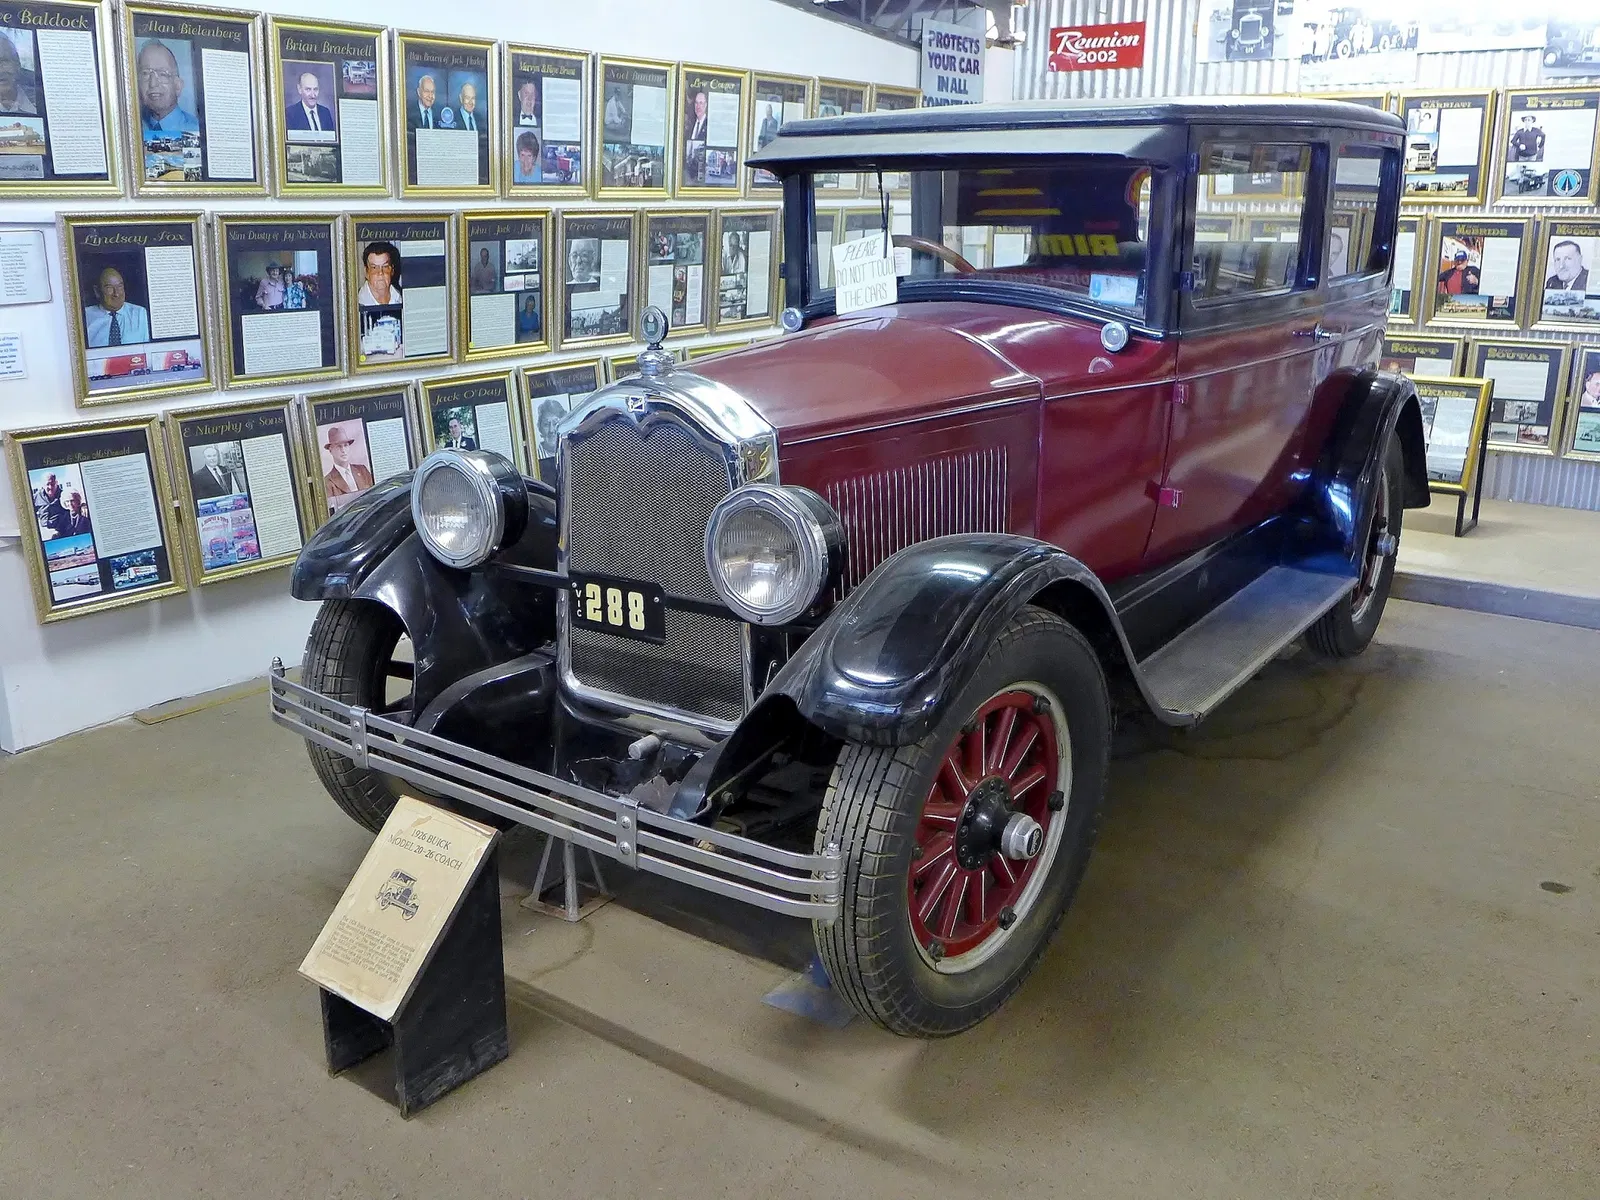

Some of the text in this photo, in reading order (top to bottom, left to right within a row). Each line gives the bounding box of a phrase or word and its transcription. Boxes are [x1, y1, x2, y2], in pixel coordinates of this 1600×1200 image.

[19, 8, 89, 29] Baldock
[180, 22, 242, 43] Bielenberg
[928, 30, 980, 55] PROTECTS
[1055, 31, 1140, 54] Reunion
[285, 37, 372, 57] Brian Bracknell
[1077, 50, 1118, 64] 2002
[928, 51, 980, 75] YOUR CAR
[937, 75, 968, 95] IN ALL
[84, 231, 184, 247] Lindsay Fox
[248, 230, 271, 242] Dusty
[360, 226, 440, 239] Denton French
[842, 237, 880, 262] PLEASE
[836, 267, 848, 288] DO
[849, 262, 867, 284] NOT
[843, 282, 888, 308] THE CARS
[432, 388, 503, 406] Jack O'Day
[195, 421, 242, 436] Murphy
[259, 416, 284, 426] Sons
[585, 583, 645, 630] 288
[411, 829, 452, 850] 1926 BUICK
[388, 834, 463, 870] MODEL 20-26 COACH
